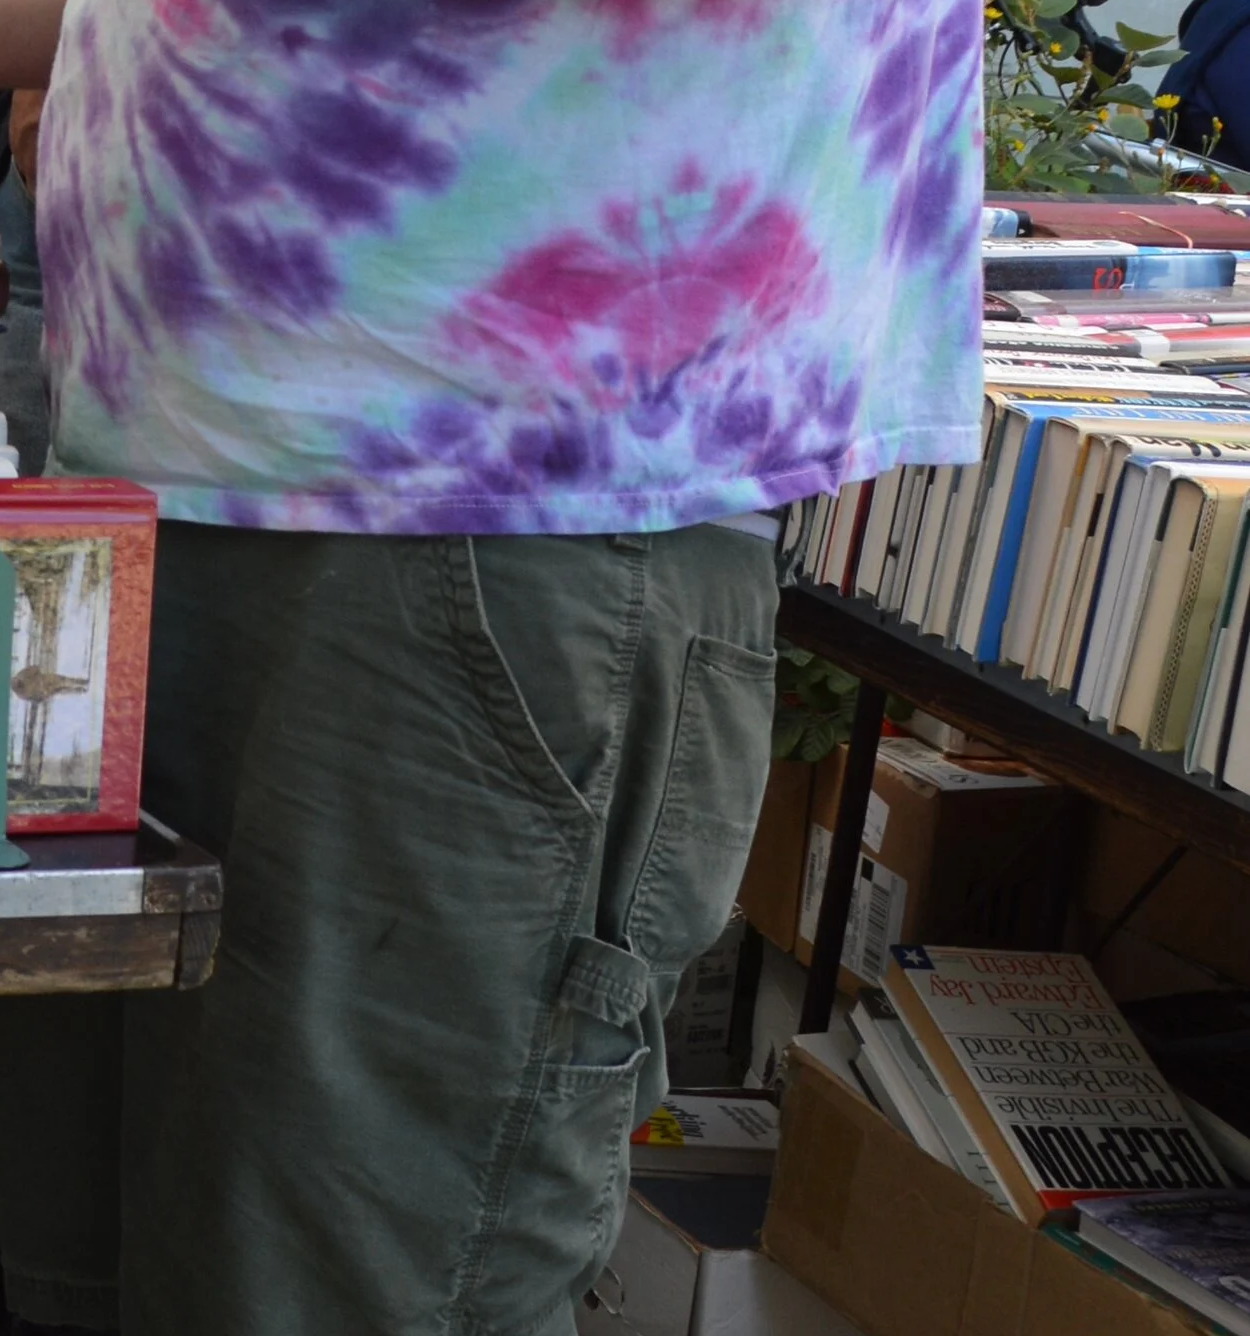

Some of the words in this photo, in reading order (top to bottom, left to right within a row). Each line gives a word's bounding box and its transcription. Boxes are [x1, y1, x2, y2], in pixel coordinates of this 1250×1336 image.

[966, 954, 1091, 984] Epstein
[929, 973, 975, 1005] Jay
[980, 980, 1106, 1010] Edward
[1012, 1011, 1070, 1035] CIA
[1072, 1012, 1121, 1036] the
[958, 1036, 1018, 1061] and
[1018, 1038, 1089, 1065] KGB
[1091, 1041, 1142, 1064] the
[970, 1065, 1099, 1094] Between
[1102, 1068, 1165, 1094] War
[994, 1095, 1113, 1123] Invisible
[1116, 1097, 1182, 1123] The
[1009, 1124, 1226, 1190] DECEPTION
